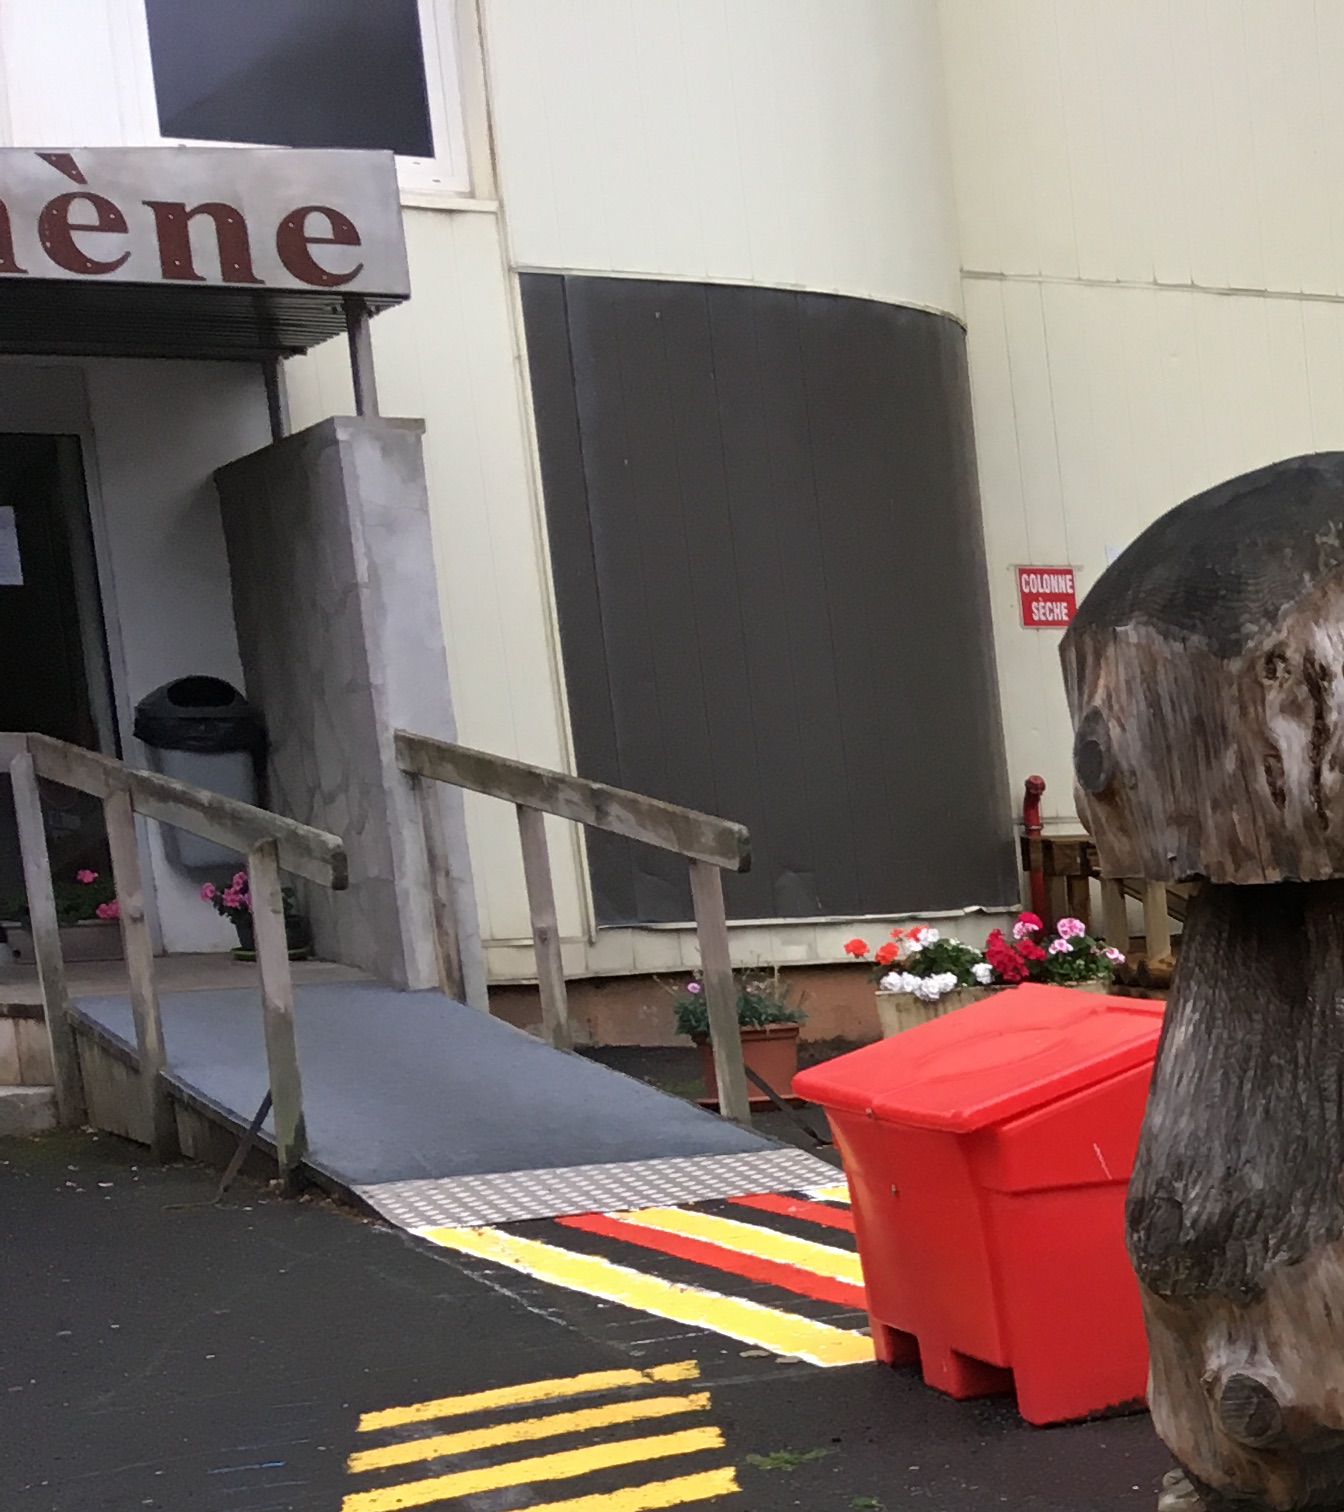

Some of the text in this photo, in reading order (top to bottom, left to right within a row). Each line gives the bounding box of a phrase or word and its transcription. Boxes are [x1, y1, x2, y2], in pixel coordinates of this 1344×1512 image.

[0, 152, 364, 288] ène
[1021, 573, 1074, 594] COLONNE
[1031, 596, 1070, 621] SÈCHE
